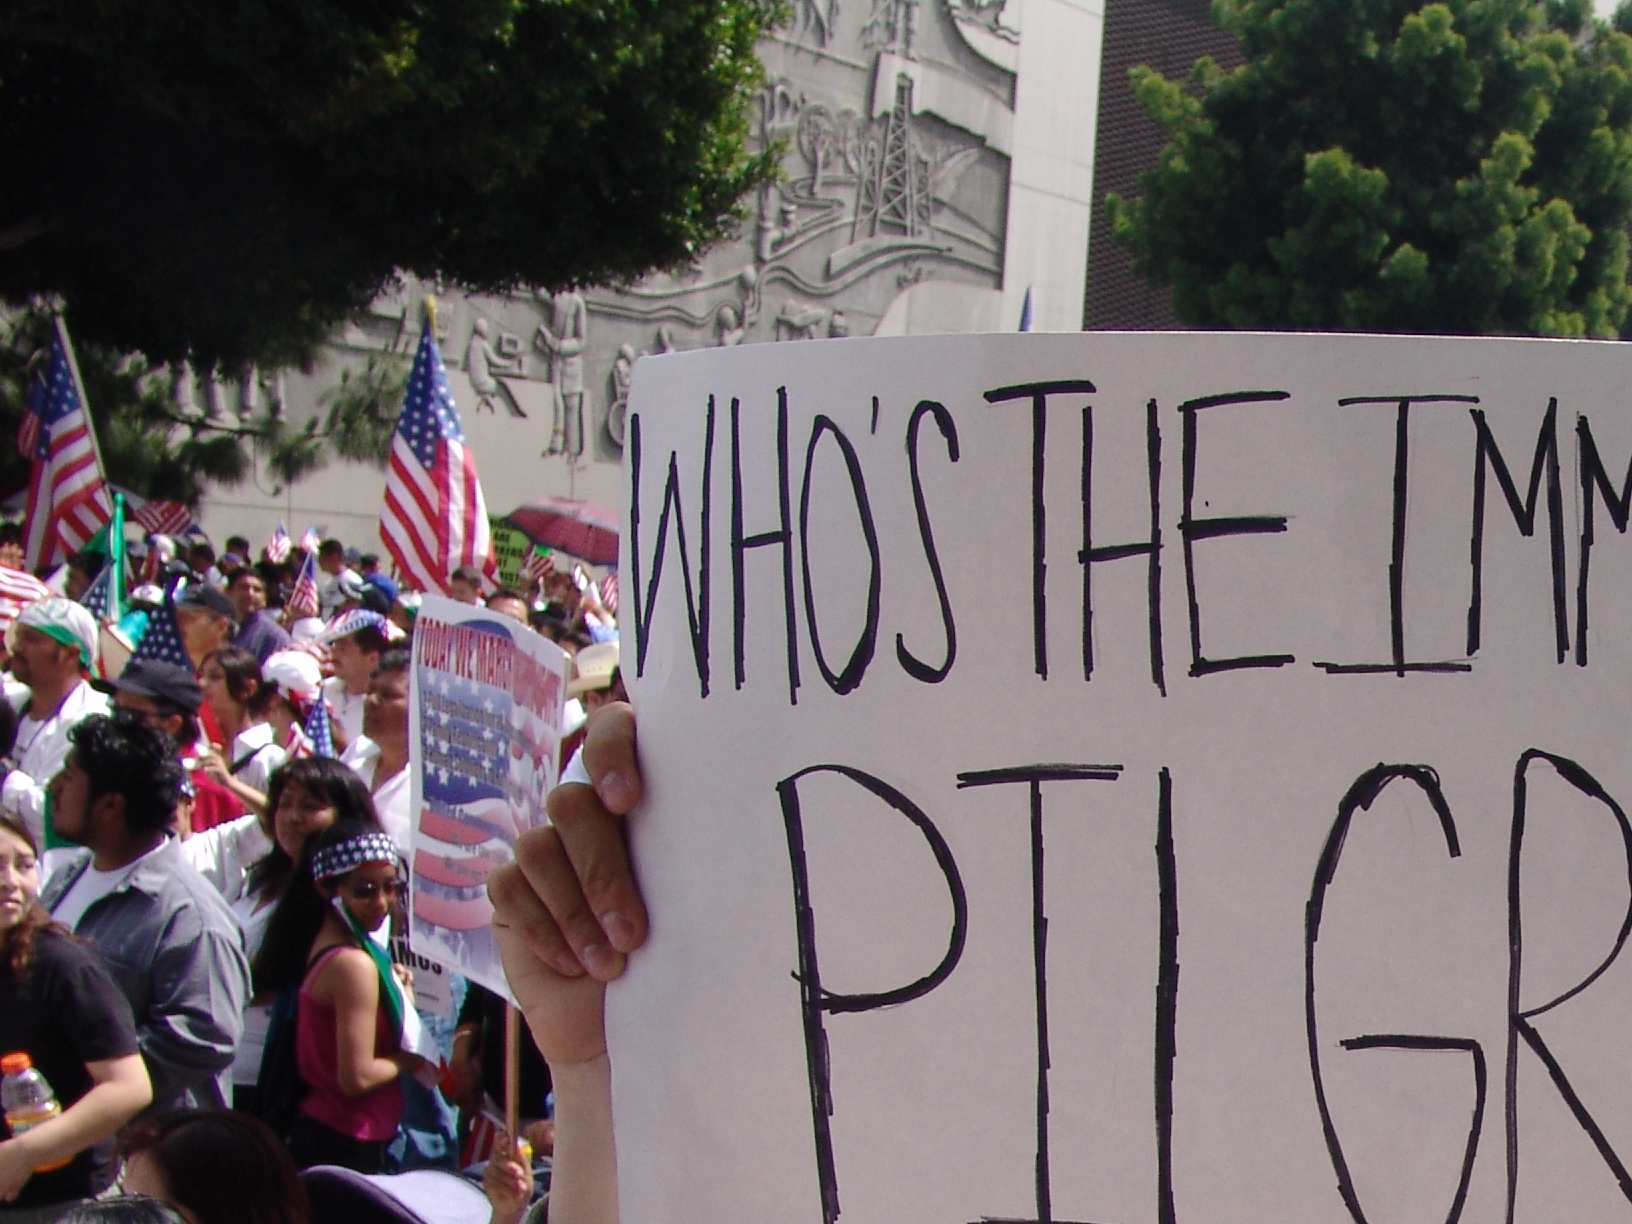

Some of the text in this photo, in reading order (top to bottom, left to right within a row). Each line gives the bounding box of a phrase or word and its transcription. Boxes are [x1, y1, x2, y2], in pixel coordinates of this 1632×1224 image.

[629, 385, 961, 707] WHO'S
[982, 378, 1297, 699] THE
[418, 616, 452, 673] TODAY
